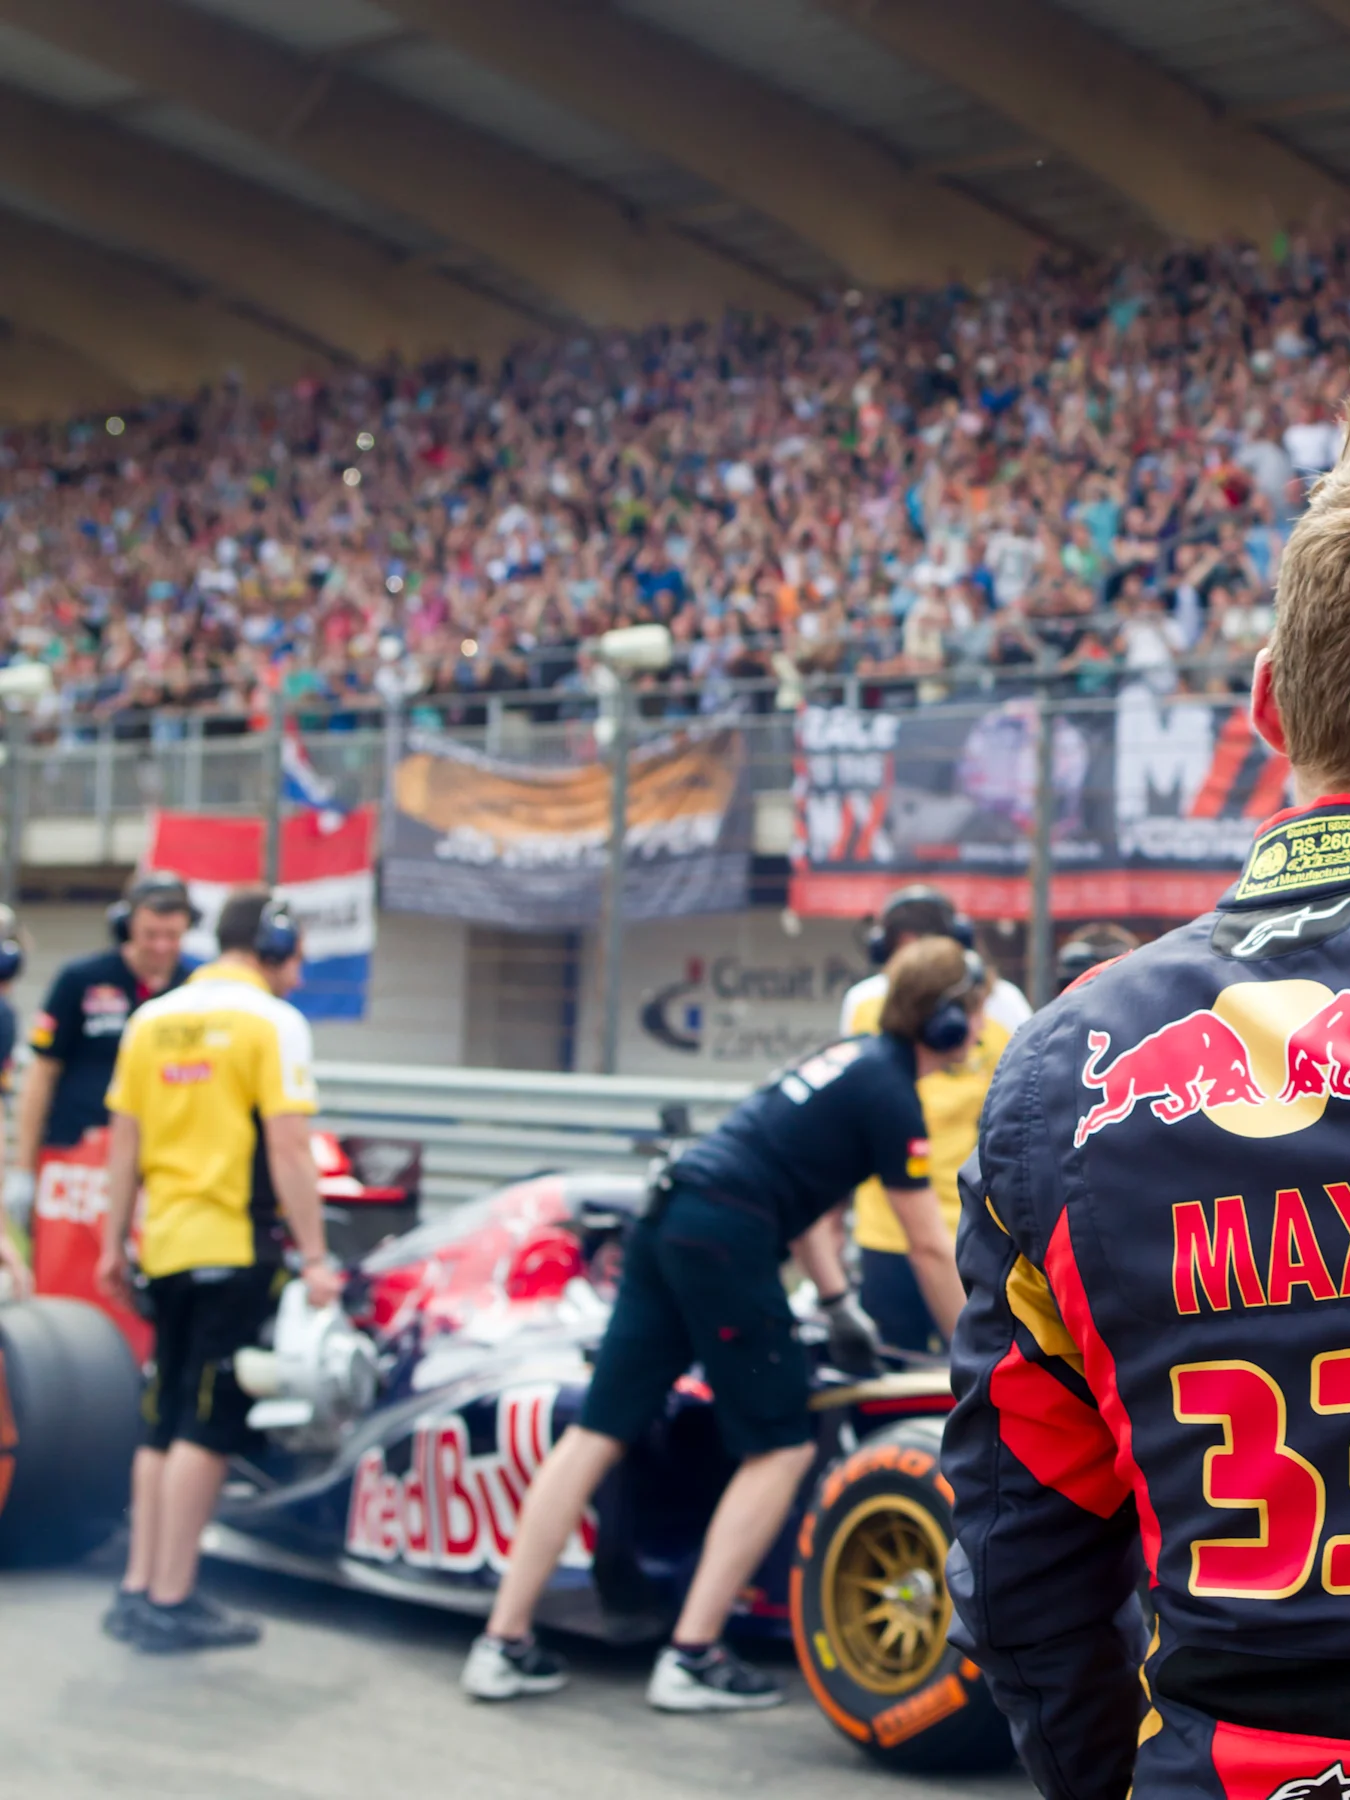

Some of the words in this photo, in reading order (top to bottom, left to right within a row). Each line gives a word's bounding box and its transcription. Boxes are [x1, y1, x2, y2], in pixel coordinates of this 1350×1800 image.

[1286, 821, 1326, 840] Standard
[1244, 881, 1267, 893] Year
[1267, 876, 1279, 888] of
